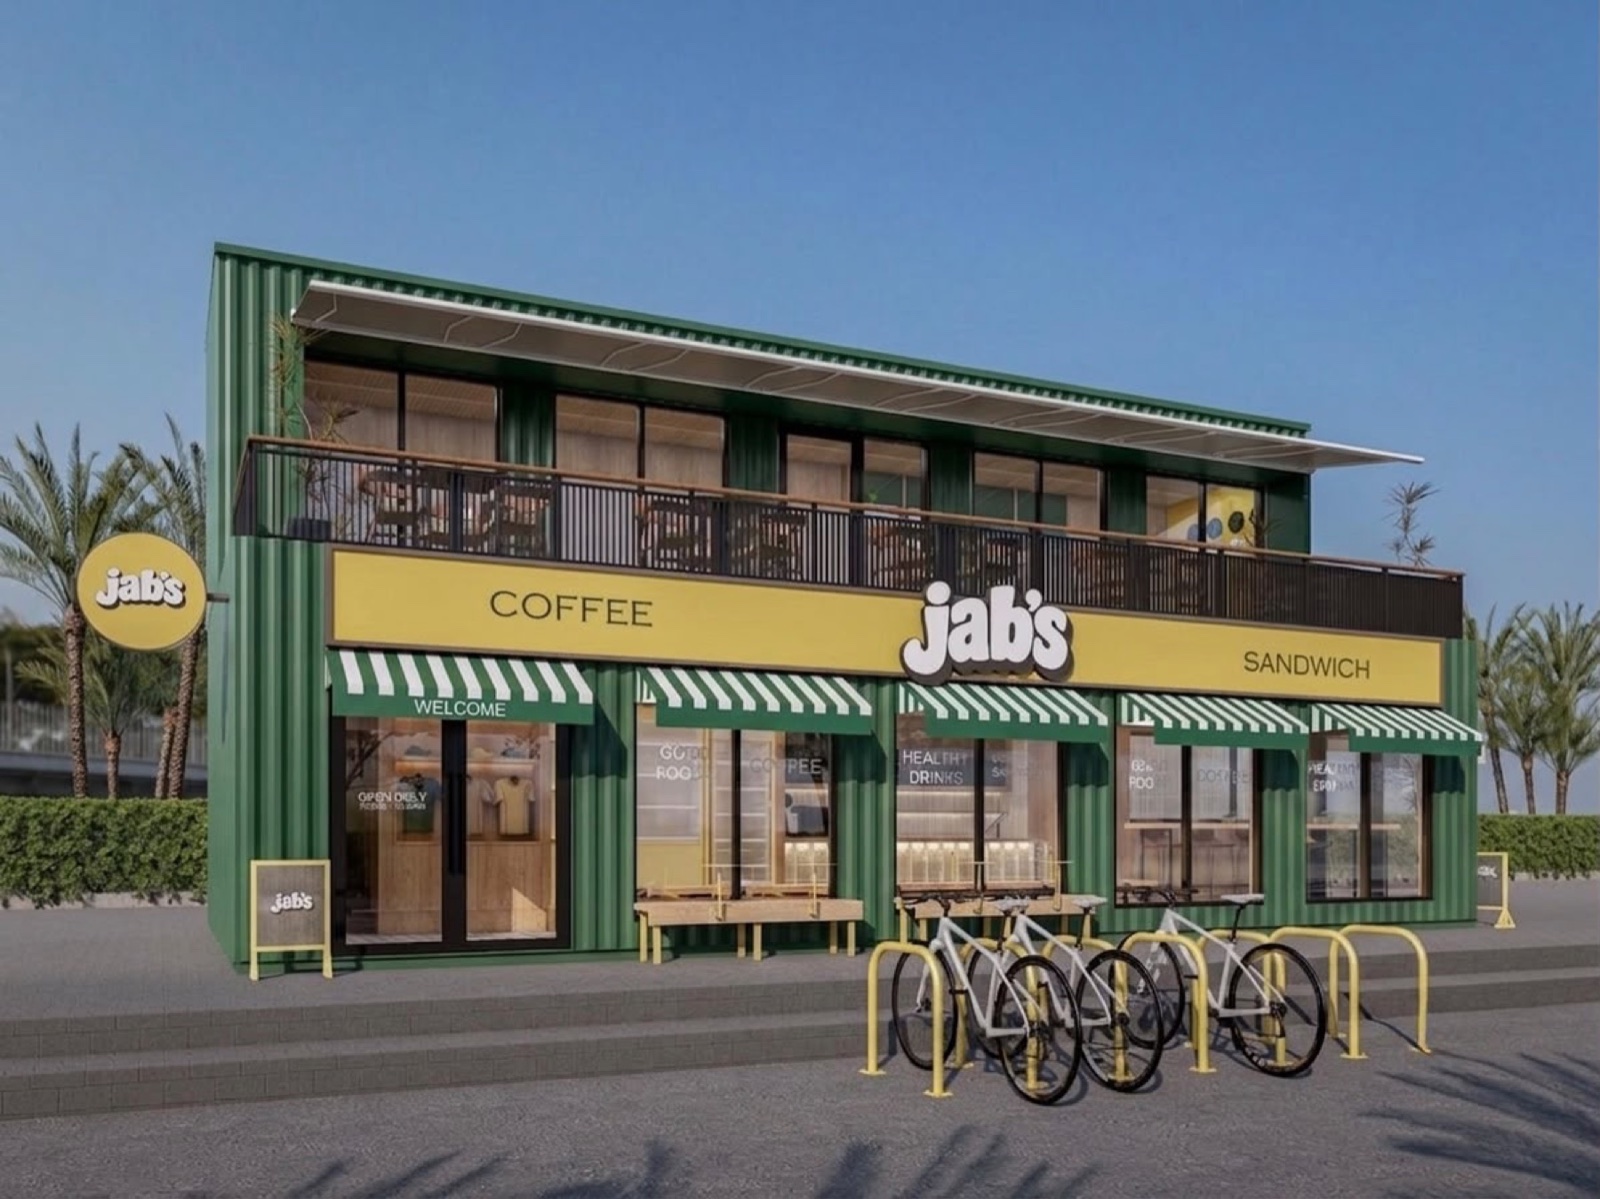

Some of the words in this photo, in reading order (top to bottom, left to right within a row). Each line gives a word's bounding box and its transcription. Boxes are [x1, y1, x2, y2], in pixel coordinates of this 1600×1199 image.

[96, 567, 186, 607] jab's
[490, 590, 654, 627] COFFEE
[901, 580, 1072, 681] jab's
[1243, 650, 1371, 680] SANDWICH
[413, 698, 507, 719] WELCOME
[909, 769, 964, 785] DRINKS
[270, 891, 314, 914] jab's
